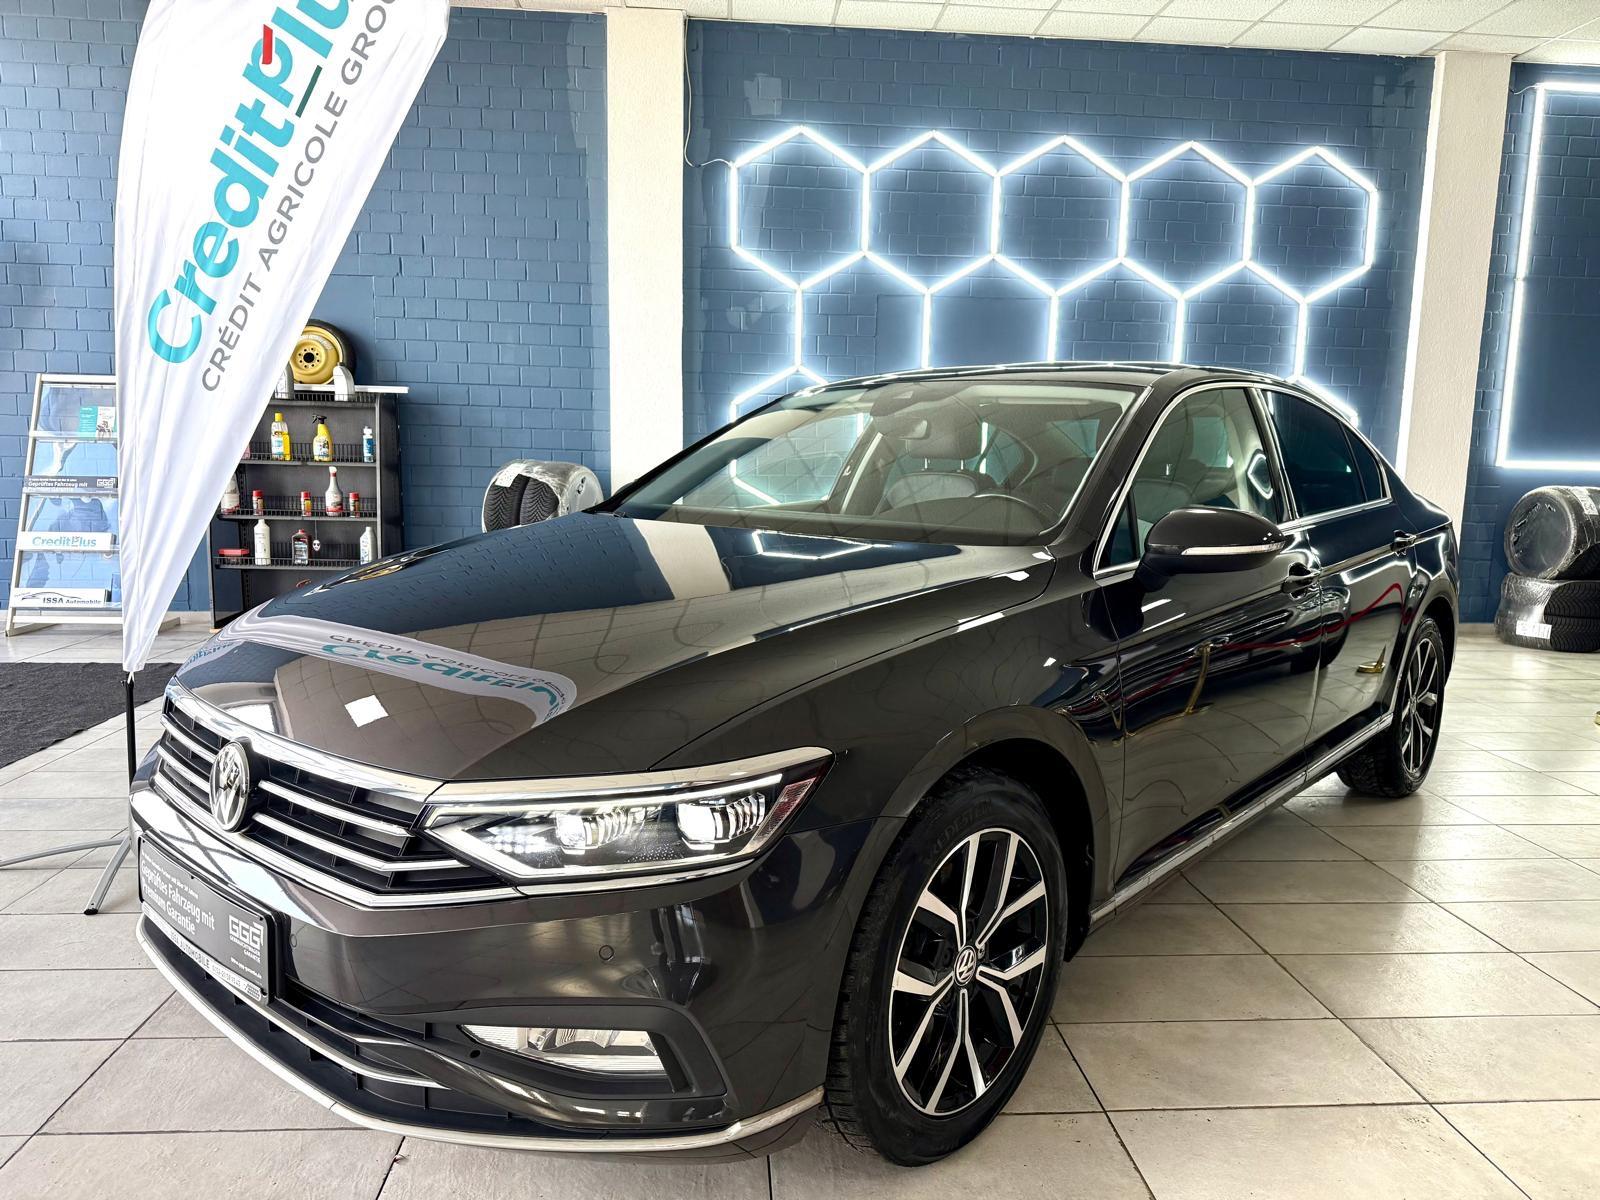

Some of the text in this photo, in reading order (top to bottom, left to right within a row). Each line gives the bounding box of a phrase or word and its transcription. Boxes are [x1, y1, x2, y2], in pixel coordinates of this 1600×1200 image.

[202, 271, 262, 392] CRÉDIT
[258, 91, 347, 272] AGRICOLE
[341, 0, 395, 86] GRO
[141, 860, 168, 895] Geprüftes
[168, 883, 201, 924] Fahrzeug
[201, 909, 215, 931] mit
[166, 900, 196, 935] Garantie
[229, 915, 261, 950] GGG
